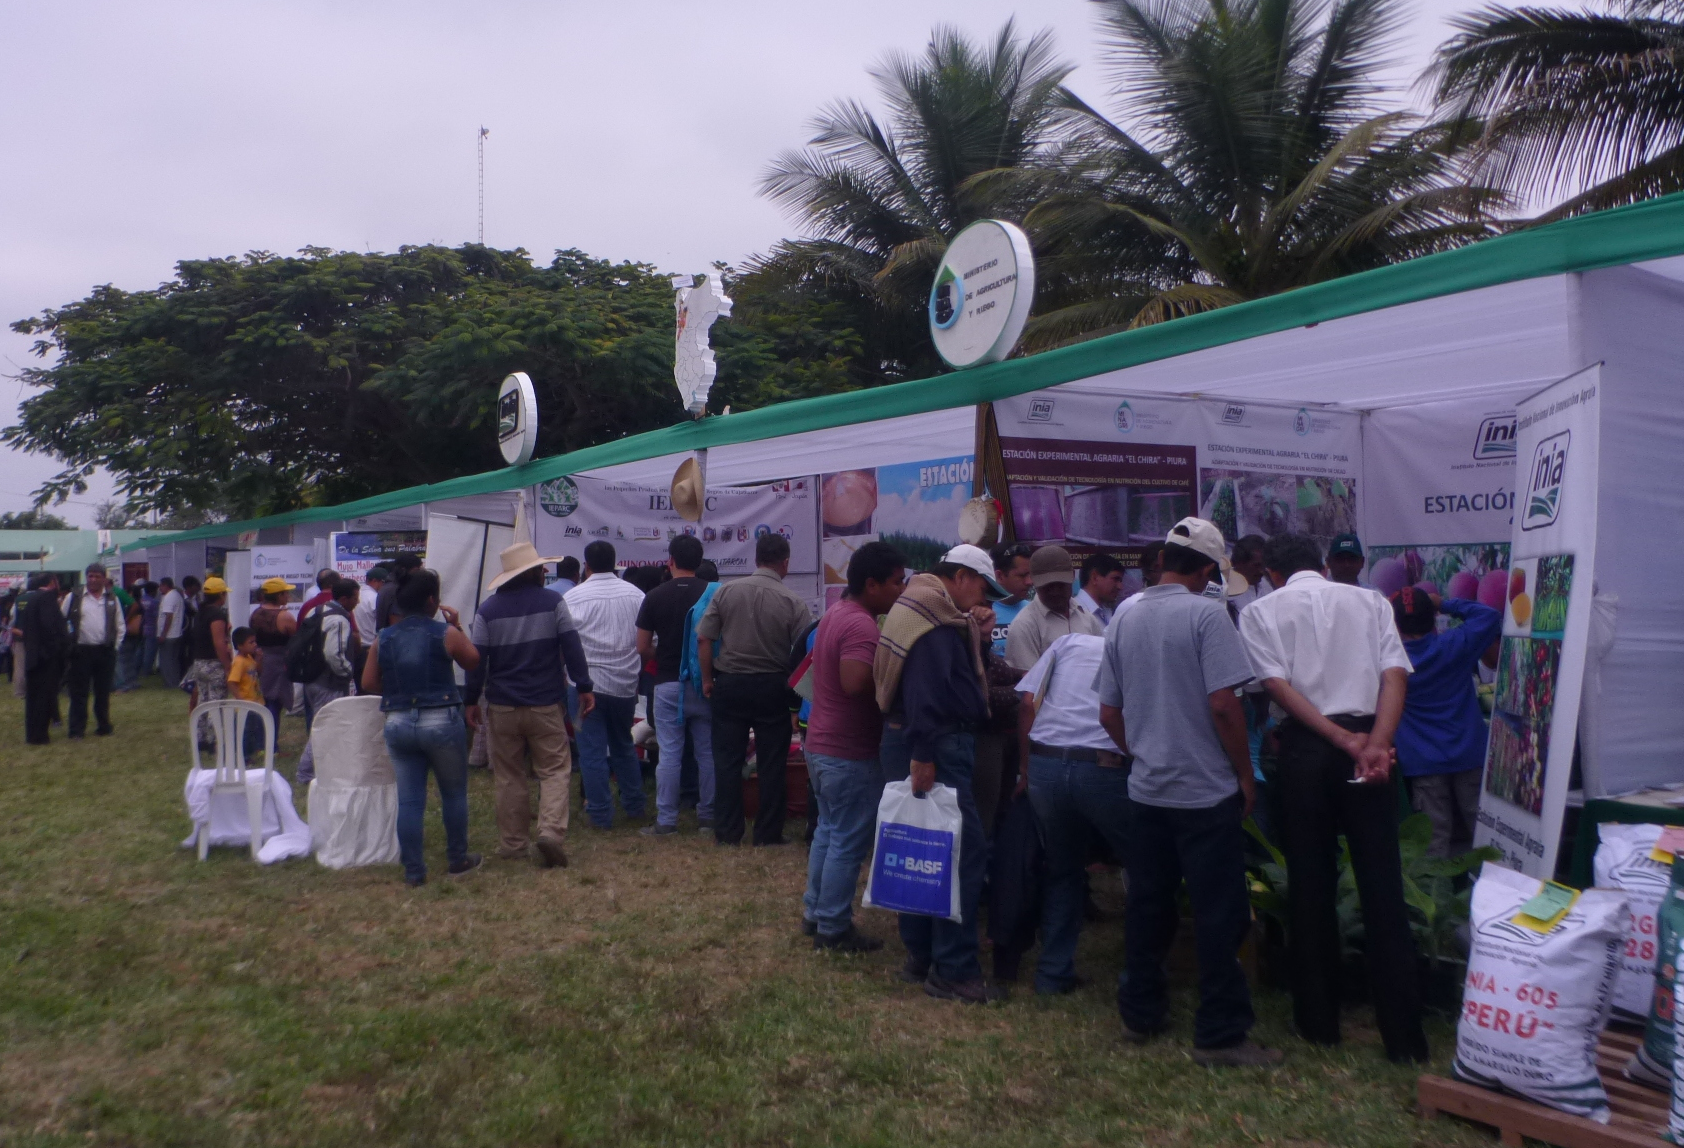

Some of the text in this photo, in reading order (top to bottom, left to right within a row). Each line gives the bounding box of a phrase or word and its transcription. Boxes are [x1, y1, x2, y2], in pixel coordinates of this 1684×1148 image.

[963, 258, 998, 280] MINISTERIO
[965, 273, 1017, 301] DE AGRICULTURA
[968, 301, 996, 318] Y RIEGO
[1033, 401, 1051, 413] inia
[1484, 419, 1517, 442] ini
[1002, 449, 1036, 459] ESTACIÓN
[1038, 452, 1092, 462] EXPERIMENTAL
[1093, 454, 1124, 463] AGRARIA
[1167, 457, 1187, 466] PIURA
[1208, 444, 1235, 454] ESTACIÓN
[1236, 446, 1275, 457] EXPERIMENTAL
[1276, 450, 1300, 459] AGRARIA
[1333, 454, 1349, 462] PIURA
[1533, 442, 1565, 492] inia
[548, 504, 571, 512] IEPARC
[361, 545, 382, 554] Selva
[905, 856, 943, 874] BASF
[883, 868, 941, 887] We create chemistry
[1467, 970, 1497, 996] NIA
[1516, 983, 1560, 1011] 605
